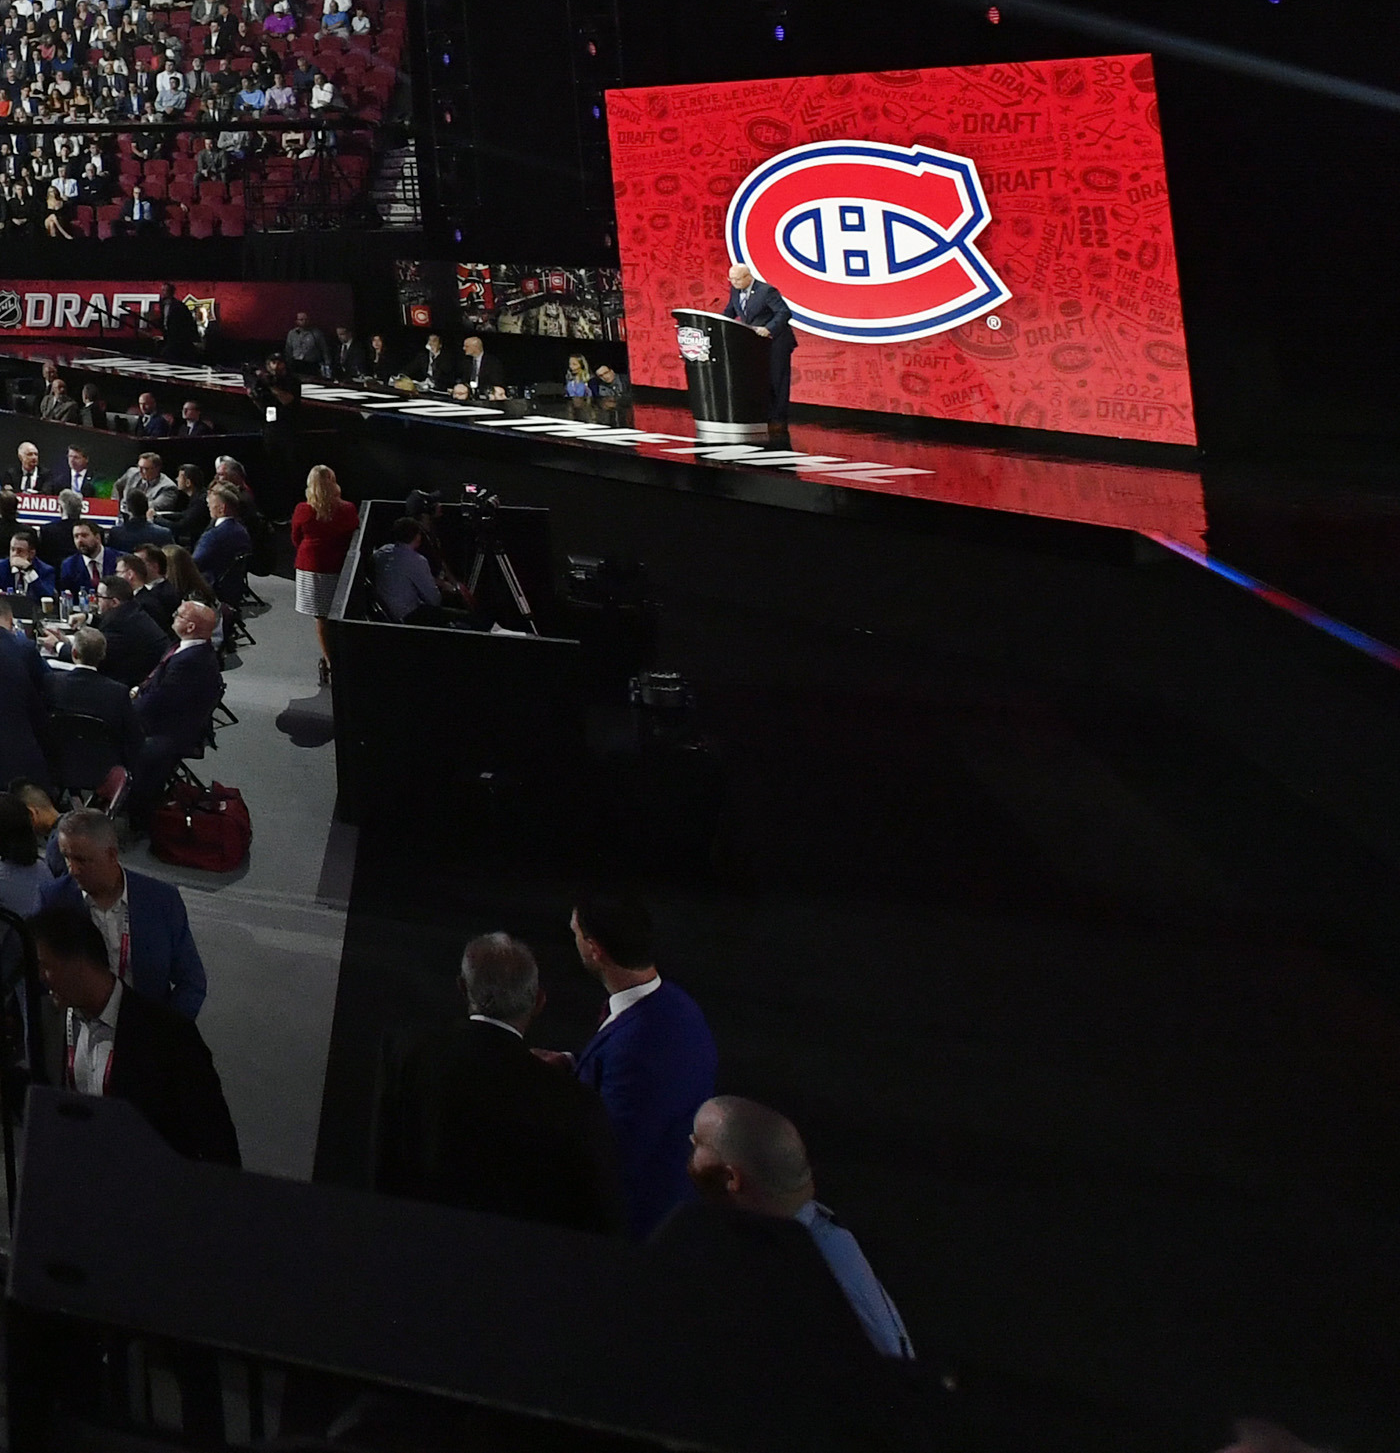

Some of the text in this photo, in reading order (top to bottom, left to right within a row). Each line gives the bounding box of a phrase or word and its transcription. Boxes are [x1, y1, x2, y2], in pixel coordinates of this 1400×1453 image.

[990, 68, 1046, 104] DRAFT
[809, 112, 860, 140] DRAFT
[962, 112, 1041, 134] DRAFT
[617, 131, 657, 145] DRAFT
[25, 293, 160, 329] DRAFT
[1024, 317, 1086, 346] DRAFT
[902, 354, 949, 370] DRAFT
[941, 384, 985, 407] DRAFT
[1115, 383, 1165, 399] 2022
[1097, 401, 1169, 426] DRAFT
[475, 415, 704, 447] THE
[659, 444, 937, 484] NHL
